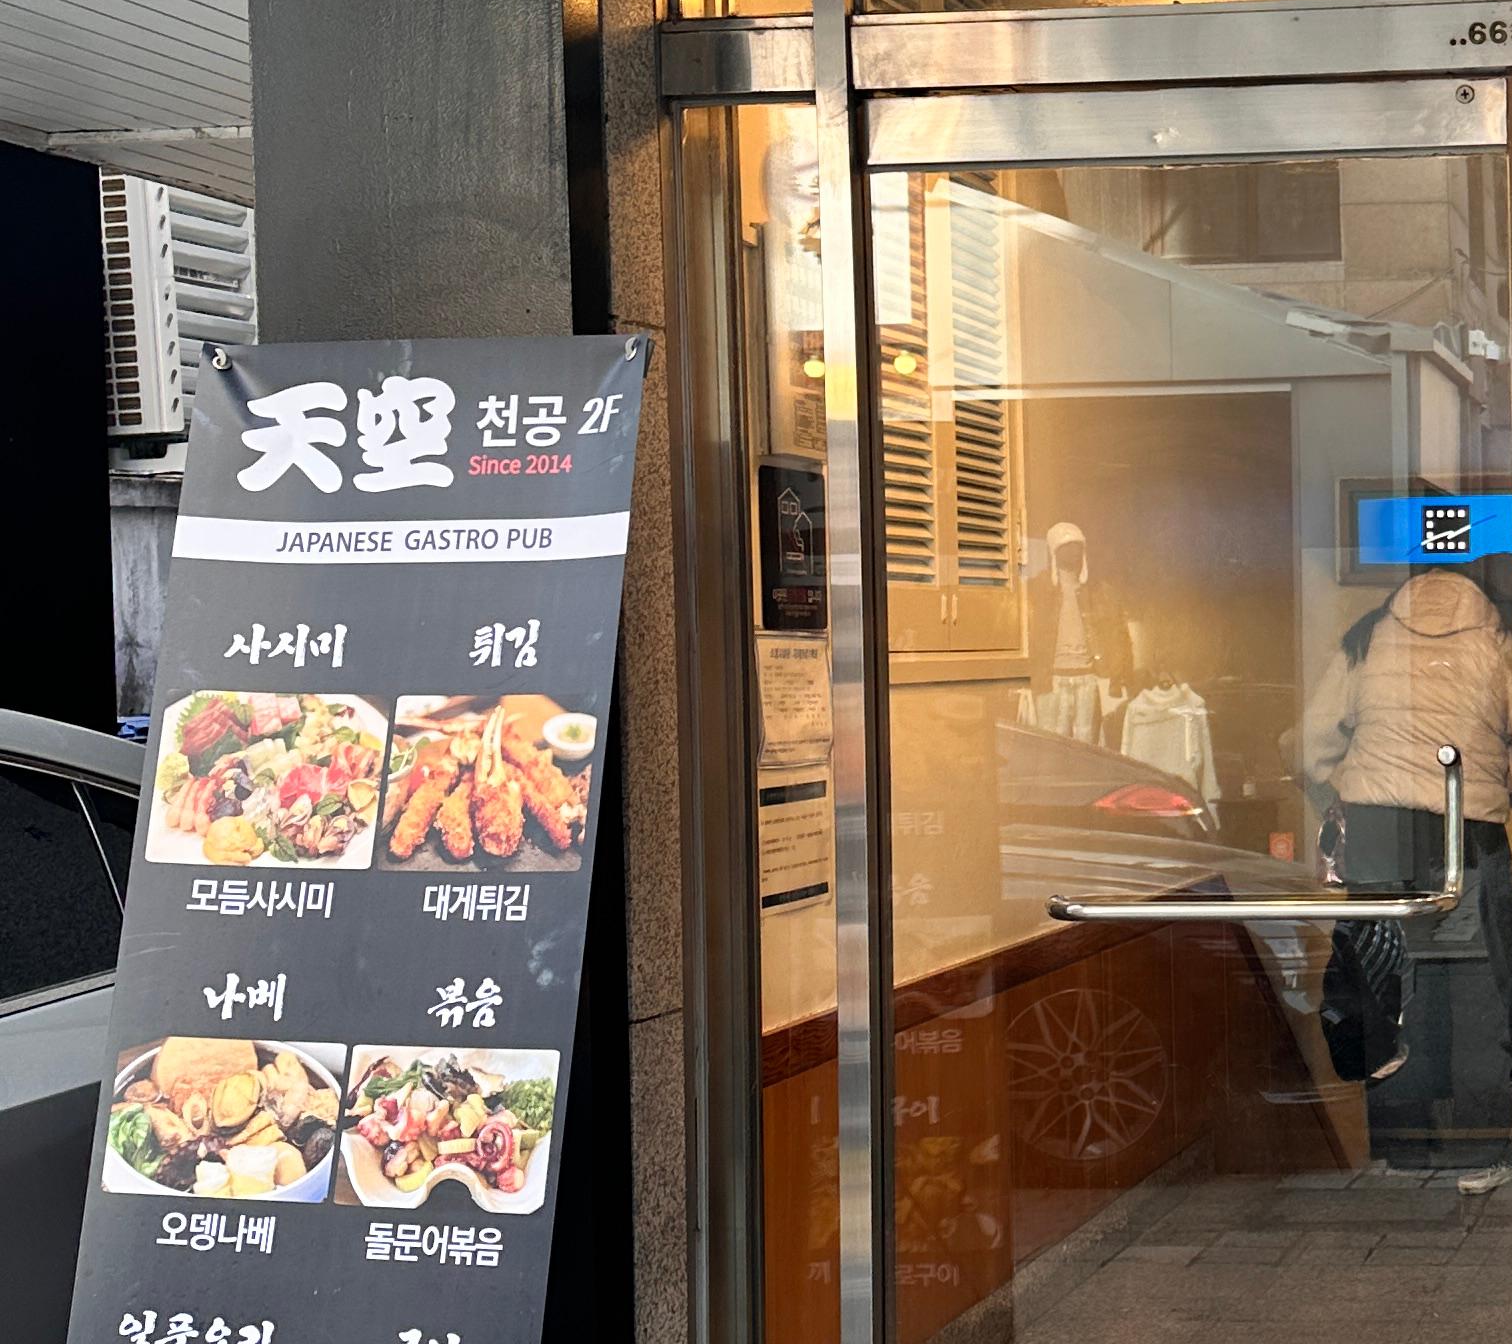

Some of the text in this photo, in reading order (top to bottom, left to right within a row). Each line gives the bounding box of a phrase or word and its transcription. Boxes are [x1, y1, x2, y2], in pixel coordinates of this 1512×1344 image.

[475, 392, 625, 449] 천공 2F
[469, 454, 573, 477] Since 2014
[275, 527, 553, 554] JAPANESE GASTRO PUB
[222, 621, 349, 669] 사시미
[467, 617, 542, 670] 튀김
[184, 877, 336, 920] 모듬사시미
[421, 883, 531, 923] 대게튀김
[201, 971, 288, 1023] 나베
[425, 976, 504, 1029] 볶음
[154, 1210, 277, 1255] 오뎅나베
[363, 1221, 505, 1268] 돌문어볶음
